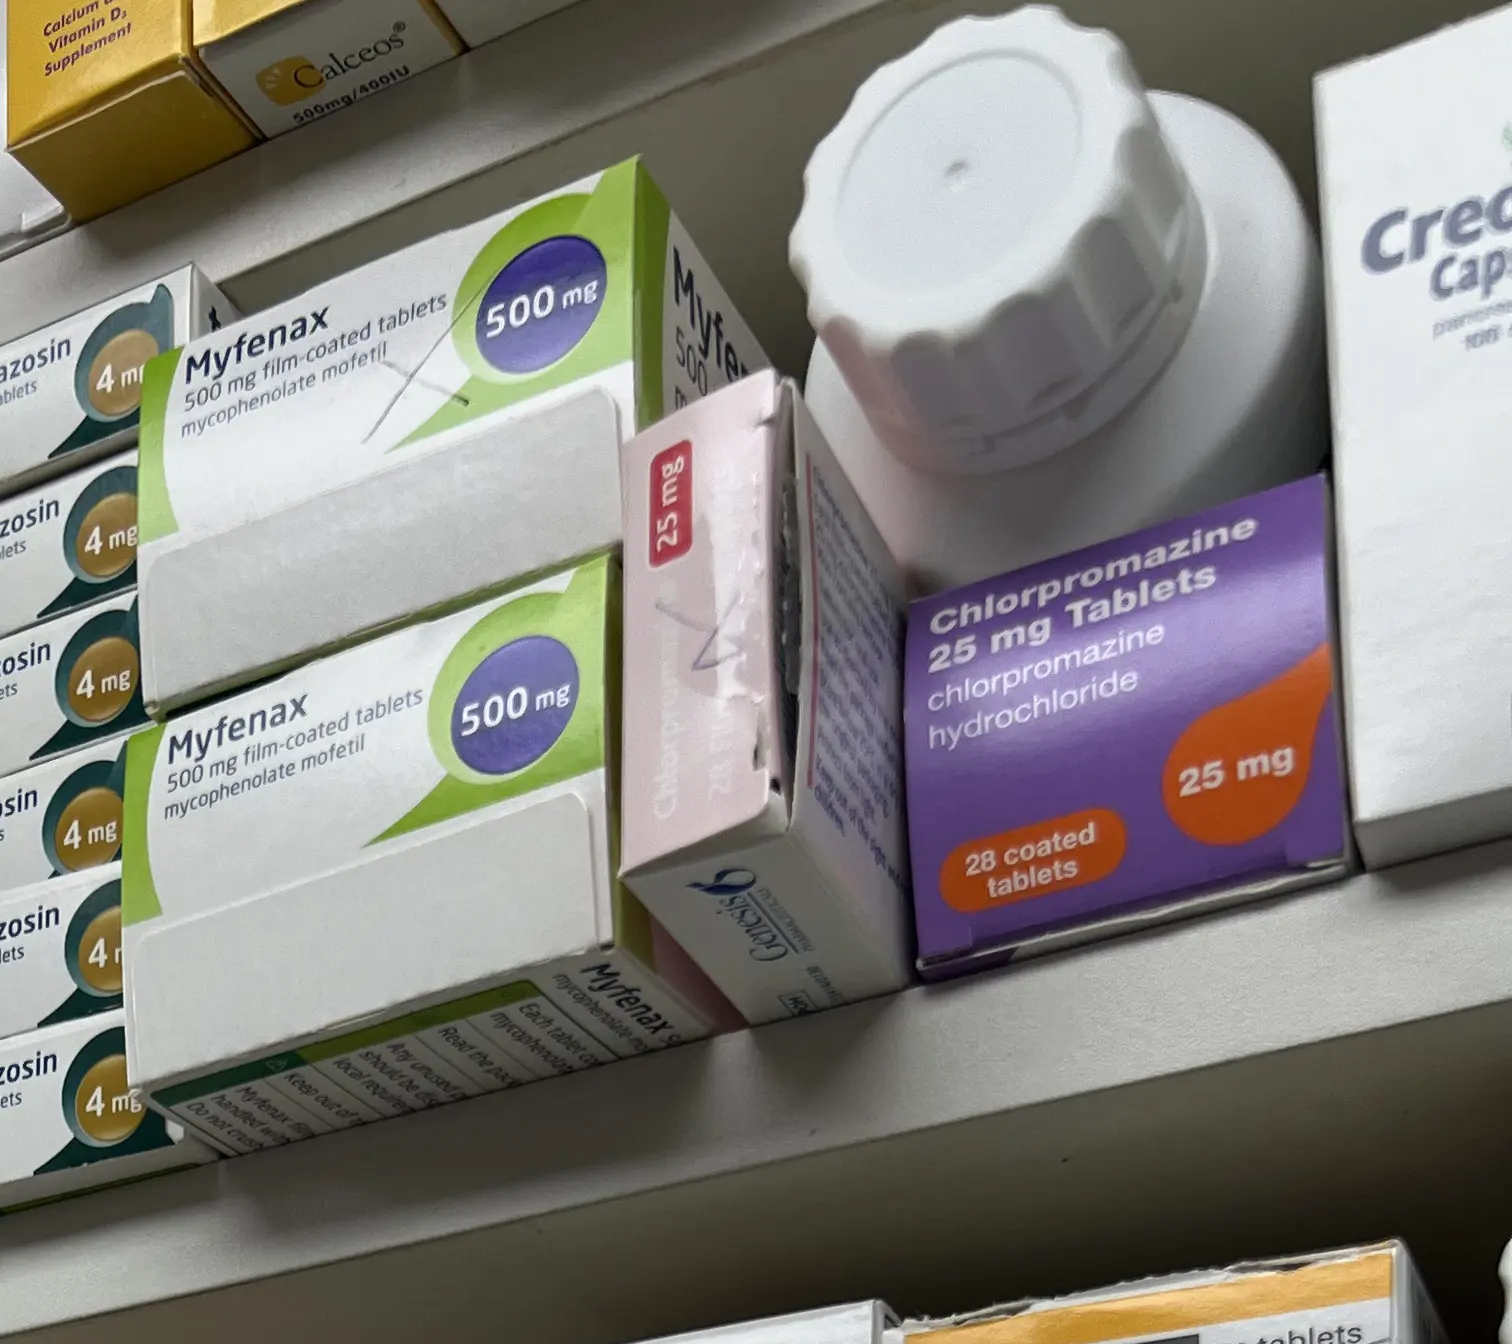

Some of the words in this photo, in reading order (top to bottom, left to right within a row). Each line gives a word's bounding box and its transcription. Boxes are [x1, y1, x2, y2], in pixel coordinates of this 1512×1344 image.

[292, 64, 411, 124] 500mg/400IU
[184, 306, 330, 389] Myfenax
[184, 382, 222, 413] 500
[226, 369, 259, 401] mg
[261, 325, 372, 385] film-coated
[377, 291, 448, 336] tablets
[179, 369, 317, 439] mycophenolate
[320, 343, 389, 389] mofetil
[659, 453, 684, 505] mg
[655, 509, 677, 552] 25
[928, 514, 1259, 636] Chlorpromazine
[928, 635, 977, 674] 25
[989, 615, 1053, 655] mg
[1063, 563, 1217, 629] Tablets
[927, 621, 1166, 714] chlorpromazine
[927, 668, 1139, 751] hydrochloride
[1178, 763, 1227, 798] 25
[1235, 744, 1296, 782] mg
[964, 846, 999, 878] 28
[1003, 821, 1097, 868] coated
[987, 855, 1078, 899] tablets
